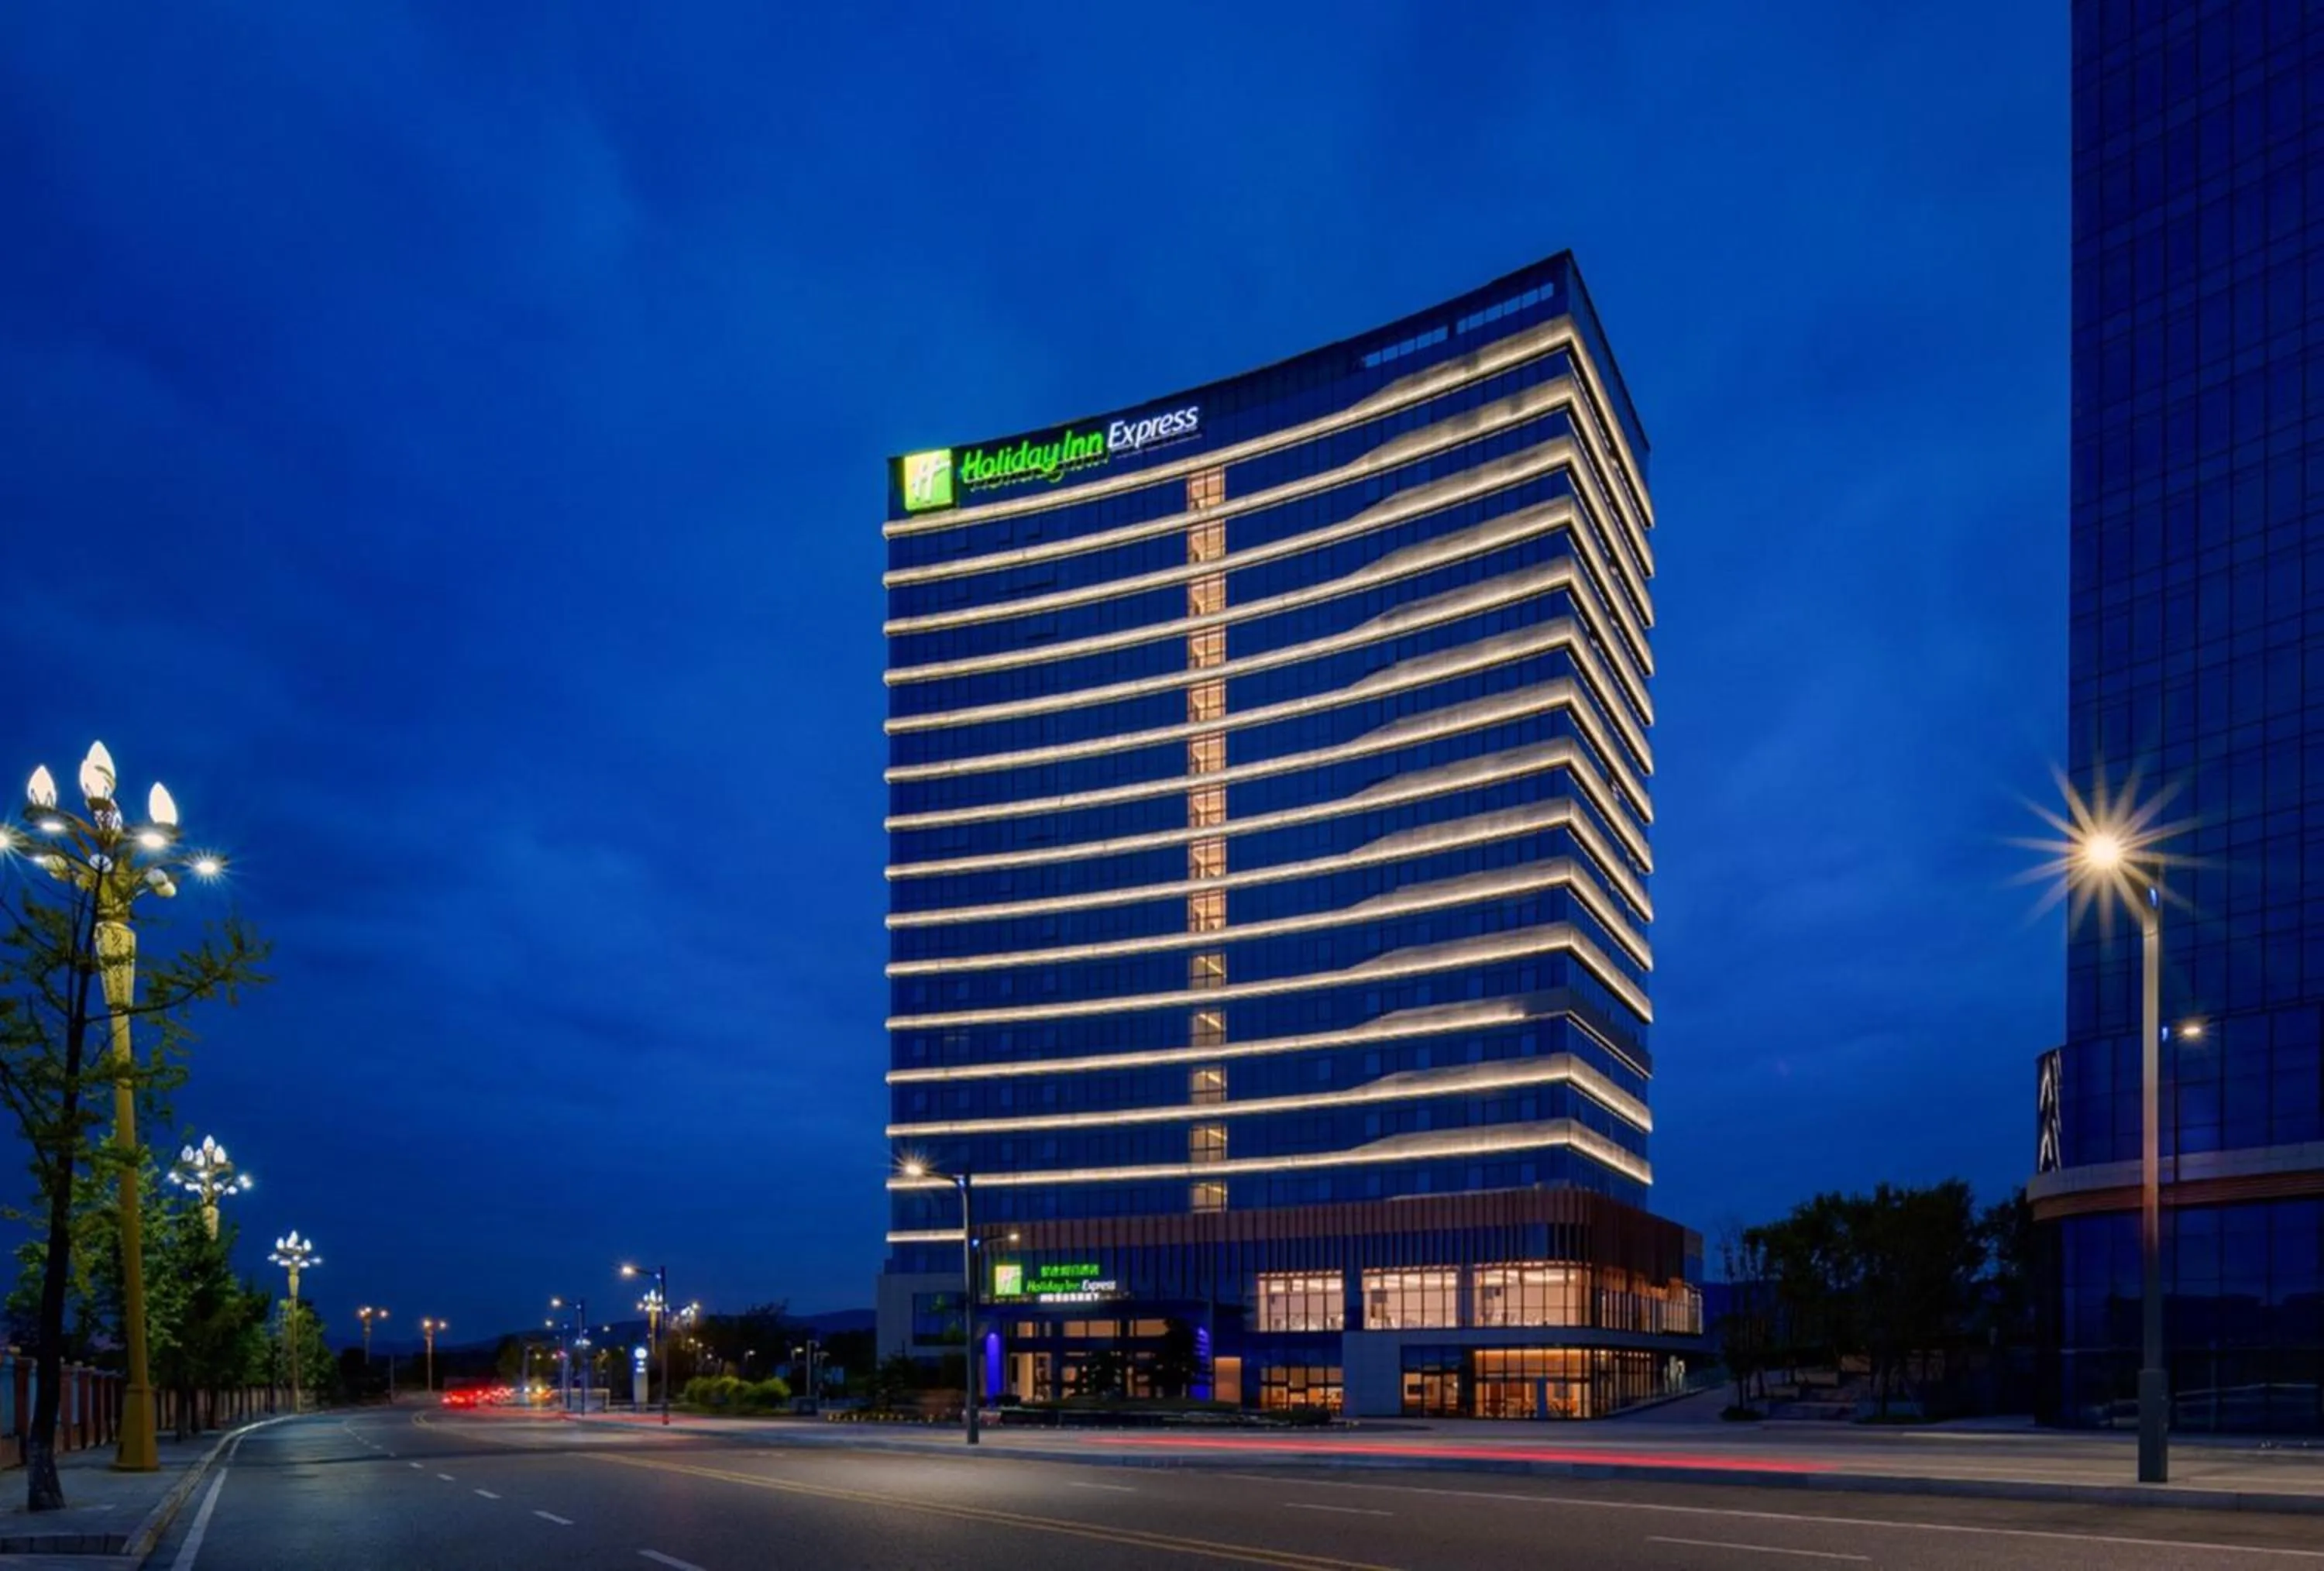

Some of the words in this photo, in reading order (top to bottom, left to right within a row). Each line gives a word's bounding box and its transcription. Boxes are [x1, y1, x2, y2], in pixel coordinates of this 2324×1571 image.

[961, 440, 1059, 482] Holiday
[1063, 429, 1104, 460] Inn
[1107, 405, 1199, 449] Express
